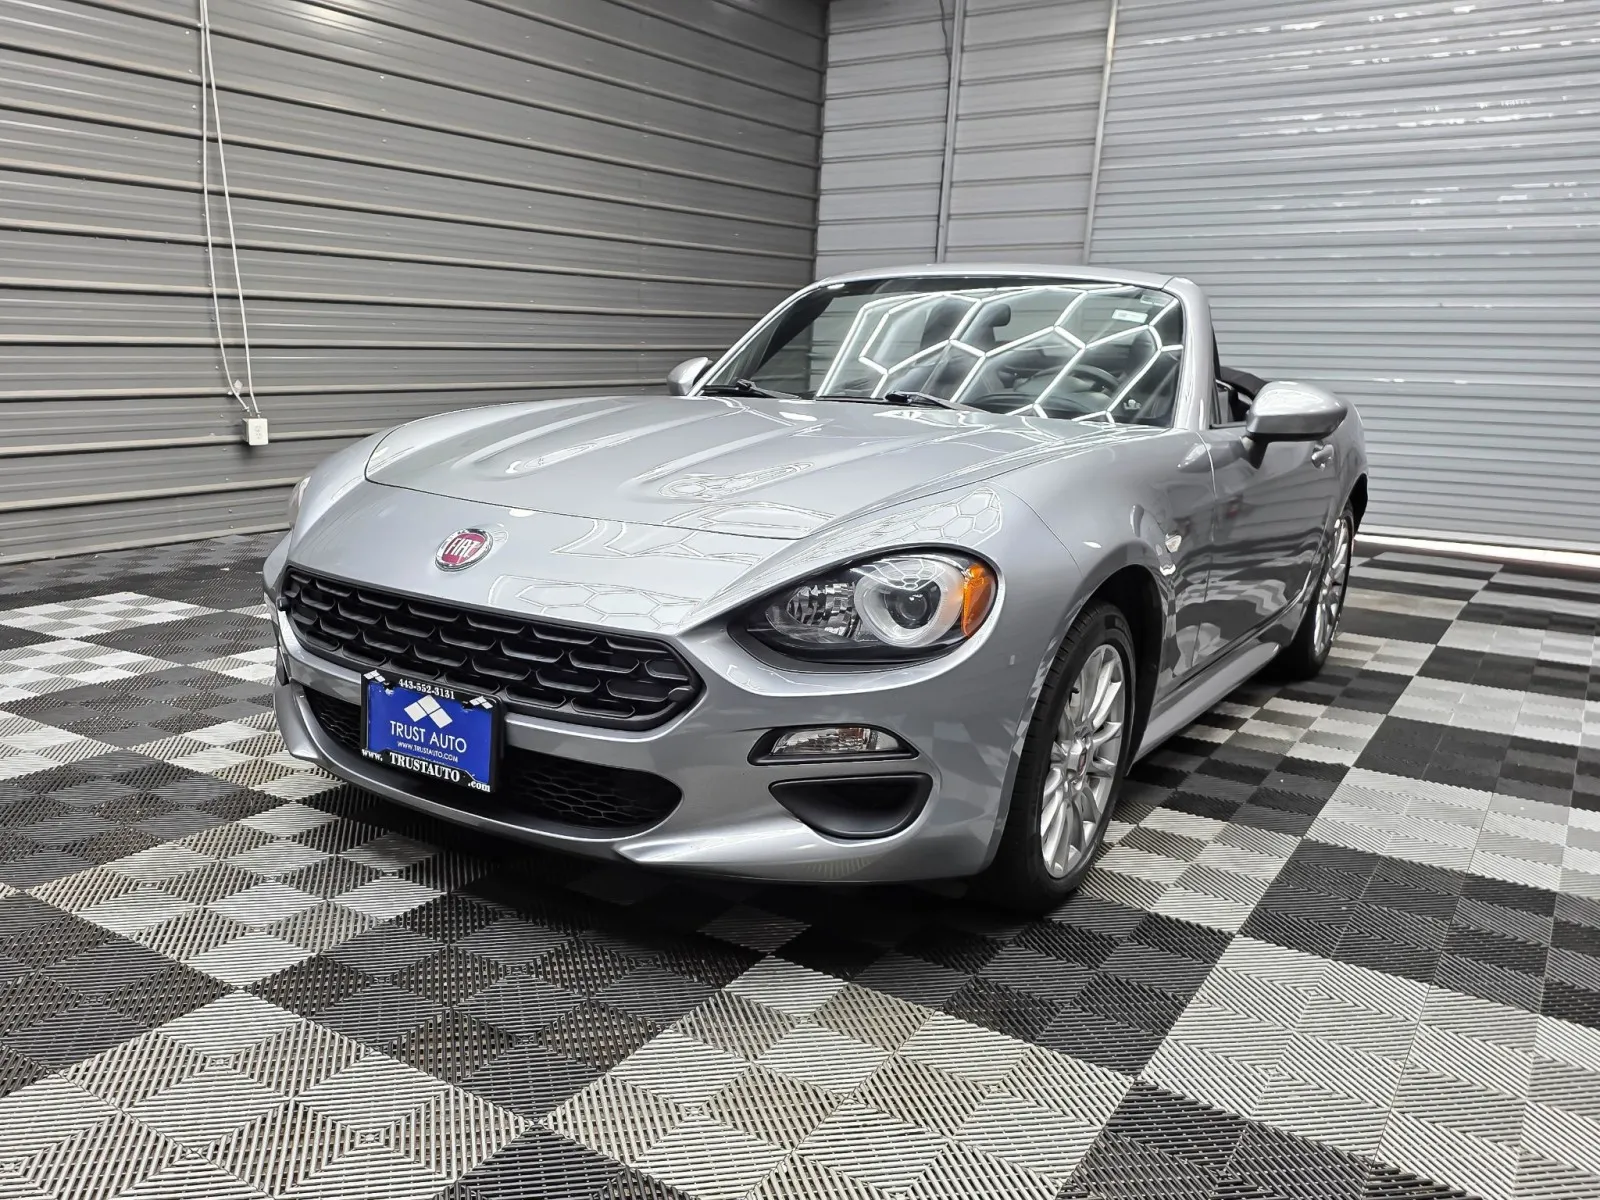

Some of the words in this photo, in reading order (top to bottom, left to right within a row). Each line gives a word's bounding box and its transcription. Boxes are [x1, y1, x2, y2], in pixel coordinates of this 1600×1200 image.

[444, 537, 481, 558] FIAT
[398, 679, 455, 700] 443-552-3131
[390, 720, 426, 743] TRUST
[429, 731, 467, 753] AUTO
[397, 741, 459, 763] WWW.TRUSTAUTO.COM
[389, 752, 460, 783] TRUSTAUTO
